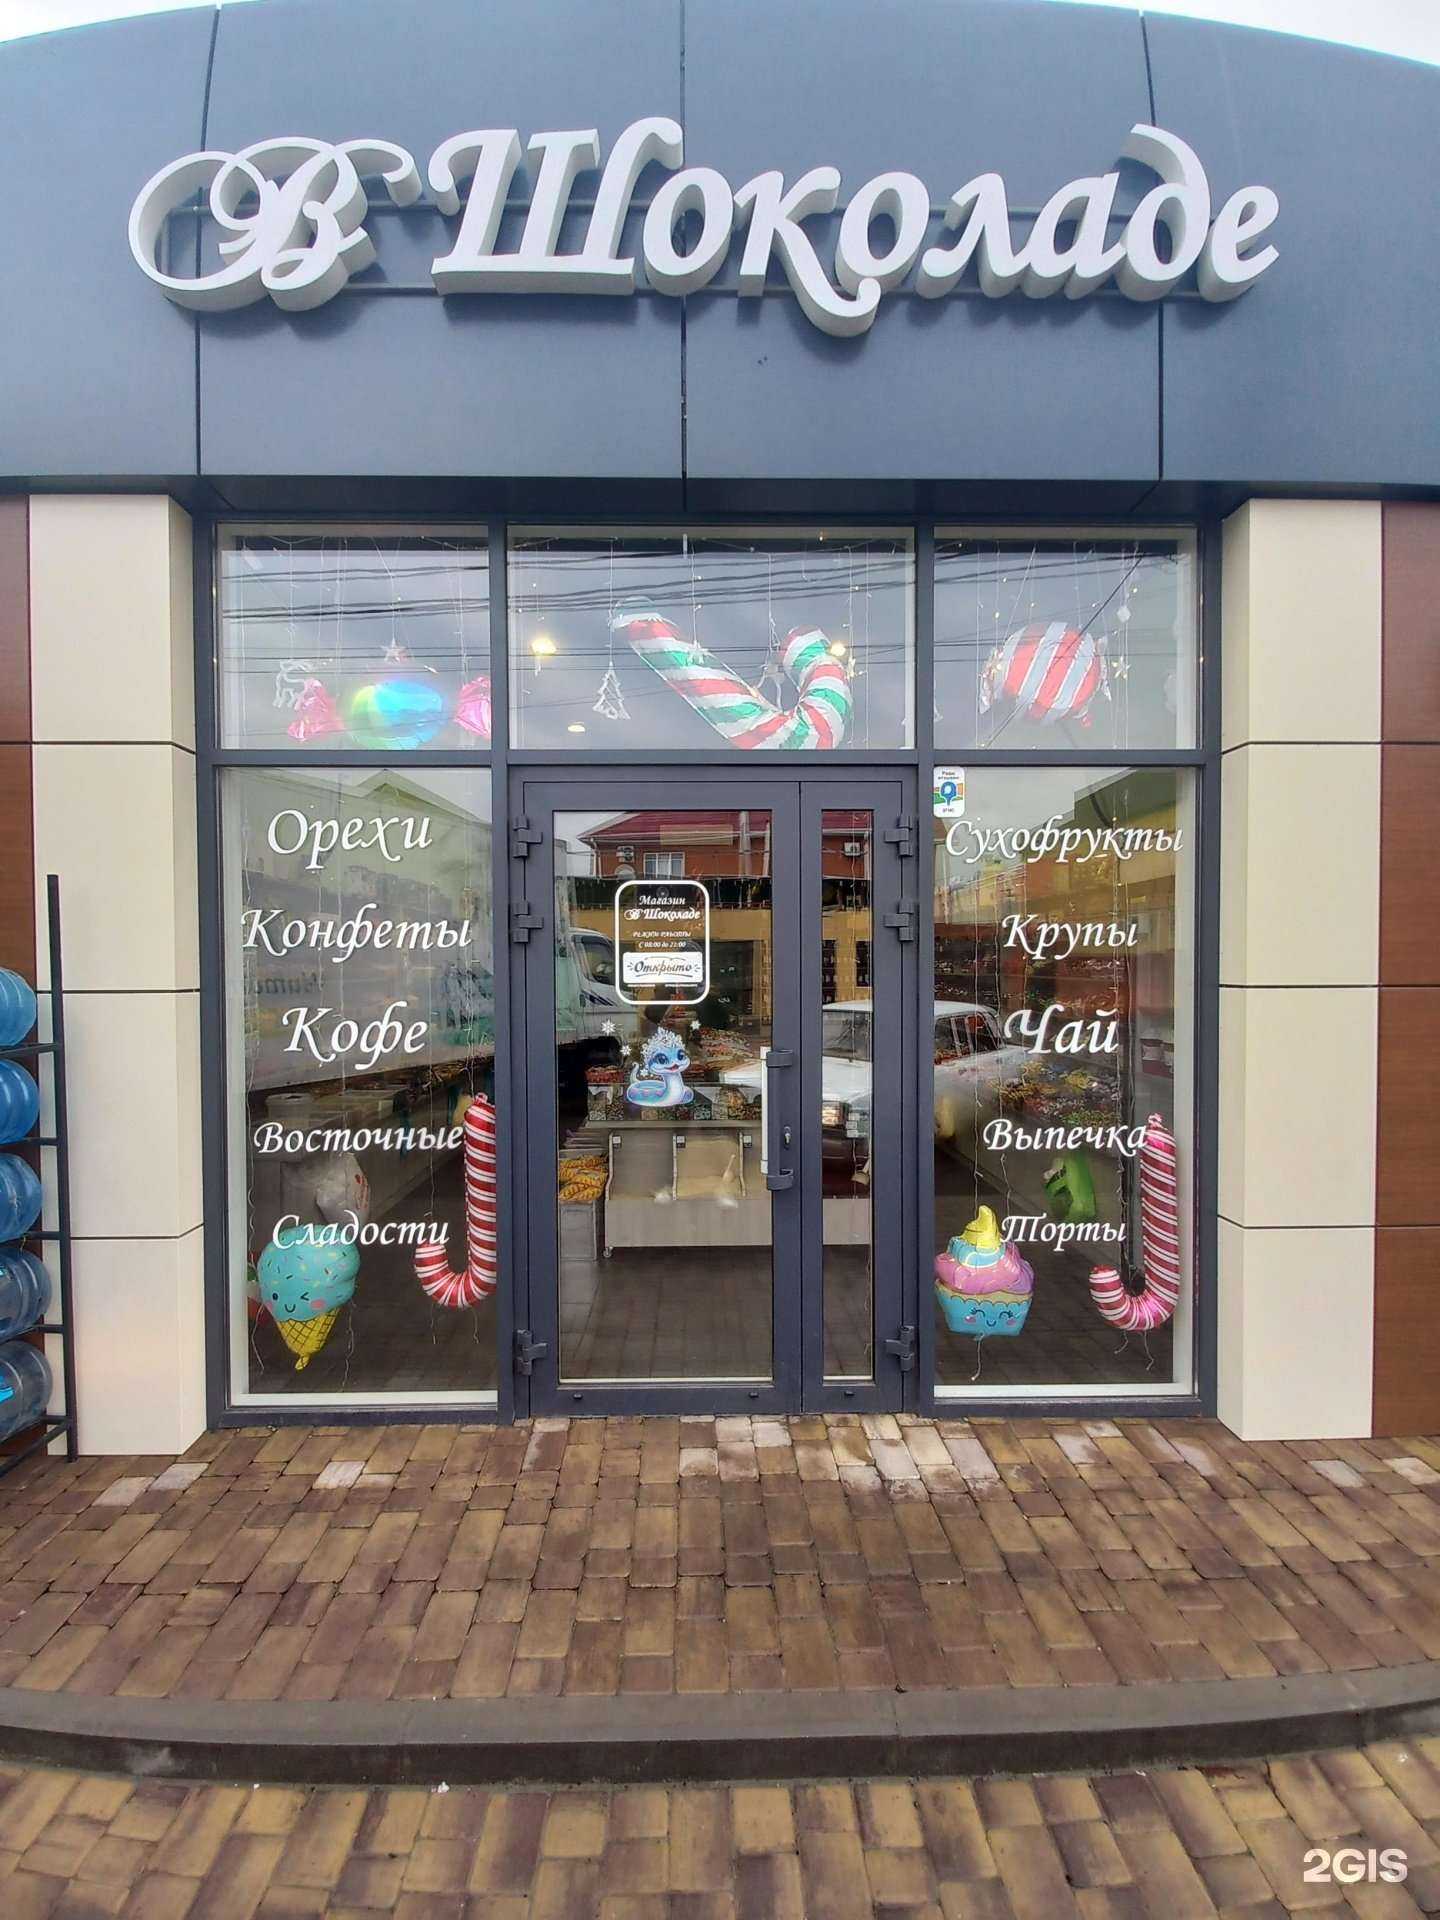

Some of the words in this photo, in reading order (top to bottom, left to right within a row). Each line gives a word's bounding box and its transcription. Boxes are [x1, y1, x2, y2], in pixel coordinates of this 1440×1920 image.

[128, 136, 421, 311] В
[428, 117, 1280, 337] Шоколаде
[267, 809, 432, 869] Орехи
[946, 815, 1183, 863] Сухофрукты
[624, 908, 643, 920] В
[643, 907, 701, 921] Шоколаде
[638, 895, 686, 905] Магазин
[241, 903, 471, 963] Конфеты
[1002, 914, 1137, 959] Крупы
[634, 960, 692, 976] Открыто
[282, 1001, 427, 1070] Кофе
[1004, 1004, 1119, 1055] Чай
[253, 1122, 464, 1153] Восточные
[983, 1119, 1148, 1156] Выпечка
[272, 1209, 449, 1250] Сладости
[1000, 1213, 1126, 1251] Торты
